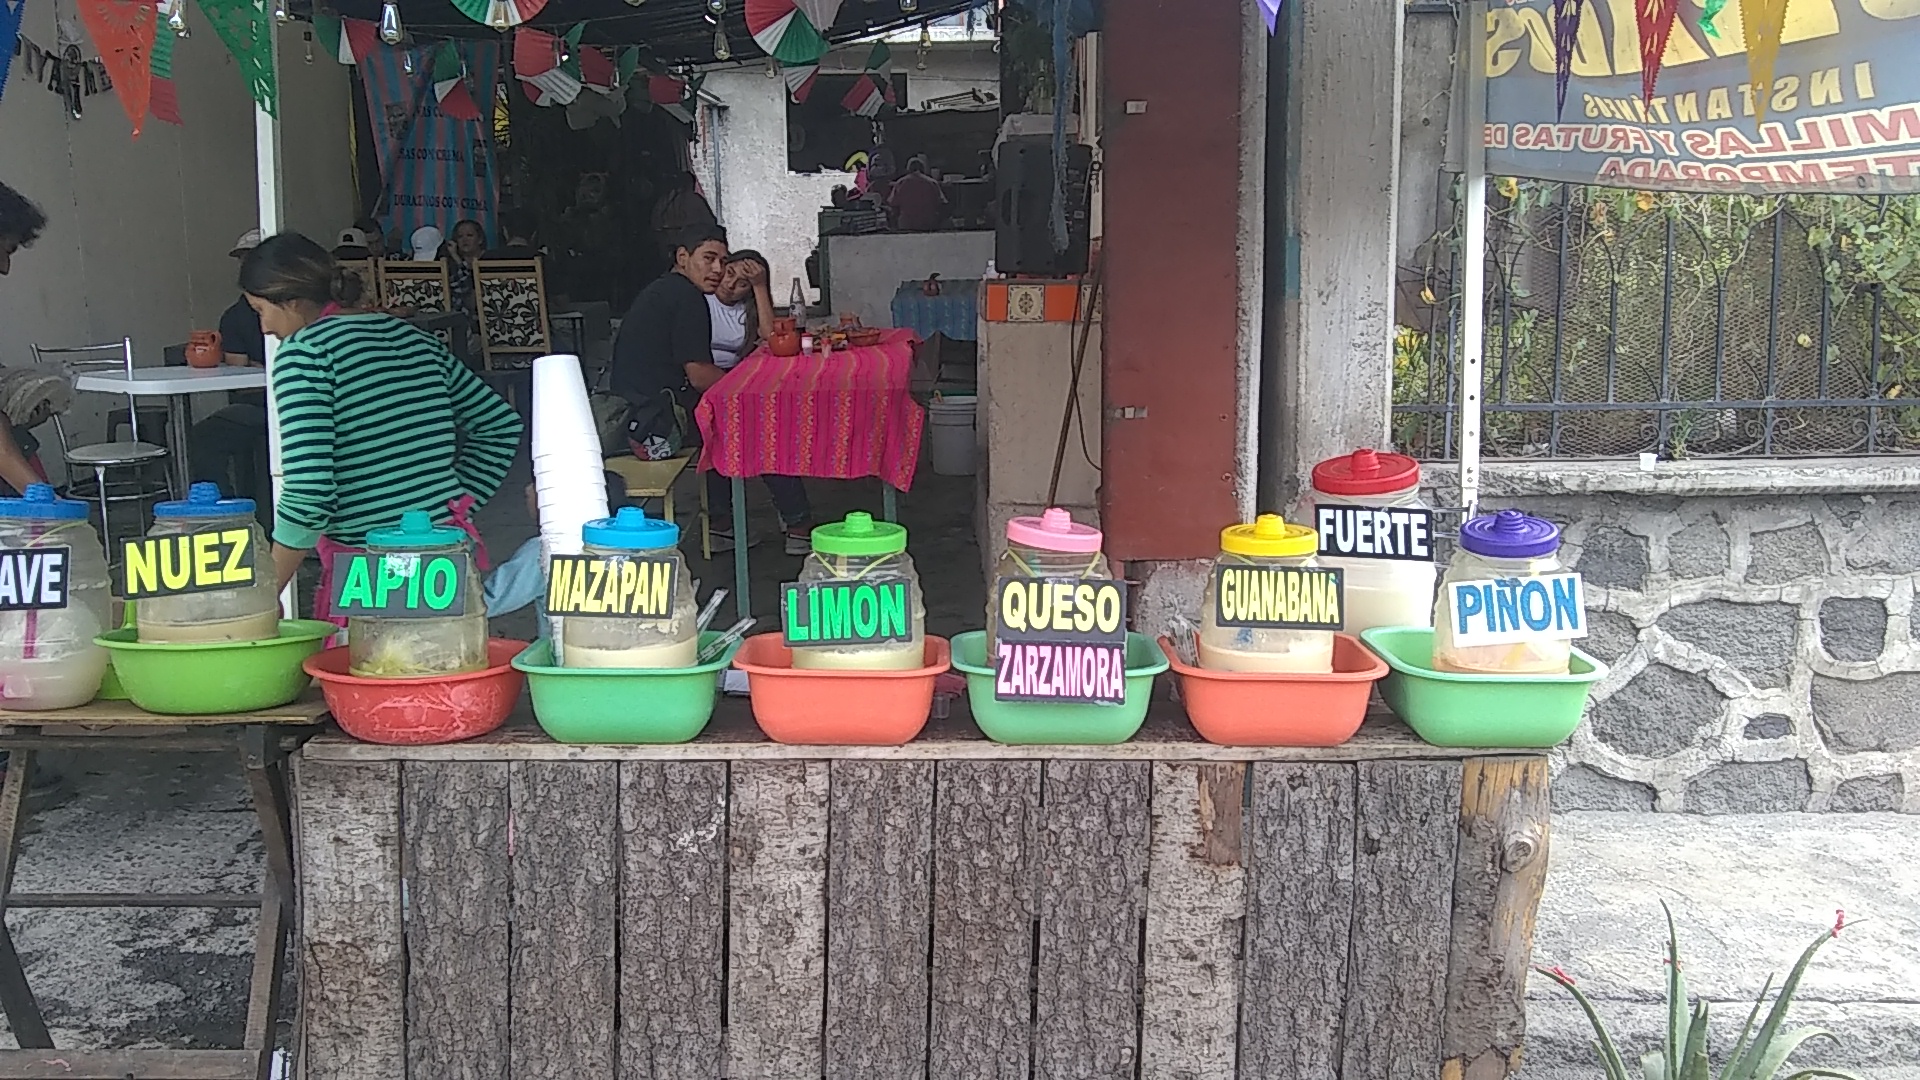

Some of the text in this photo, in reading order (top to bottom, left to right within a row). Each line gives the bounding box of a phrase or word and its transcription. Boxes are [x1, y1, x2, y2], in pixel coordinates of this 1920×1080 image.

[1319, 508, 1427, 556] FUERTE
[125, 528, 252, 594] NUEZ
[339, 555, 458, 610] APIO
[548, 559, 671, 615] MAZAPAN
[786, 584, 907, 640] LIMON
[1002, 581, 1121, 633] QUESO
[1221, 568, 1340, 625] GUANABANA
[1456, 577, 1577, 633] PIÑON
[995, 645, 1122, 697] ZARZAMORA
